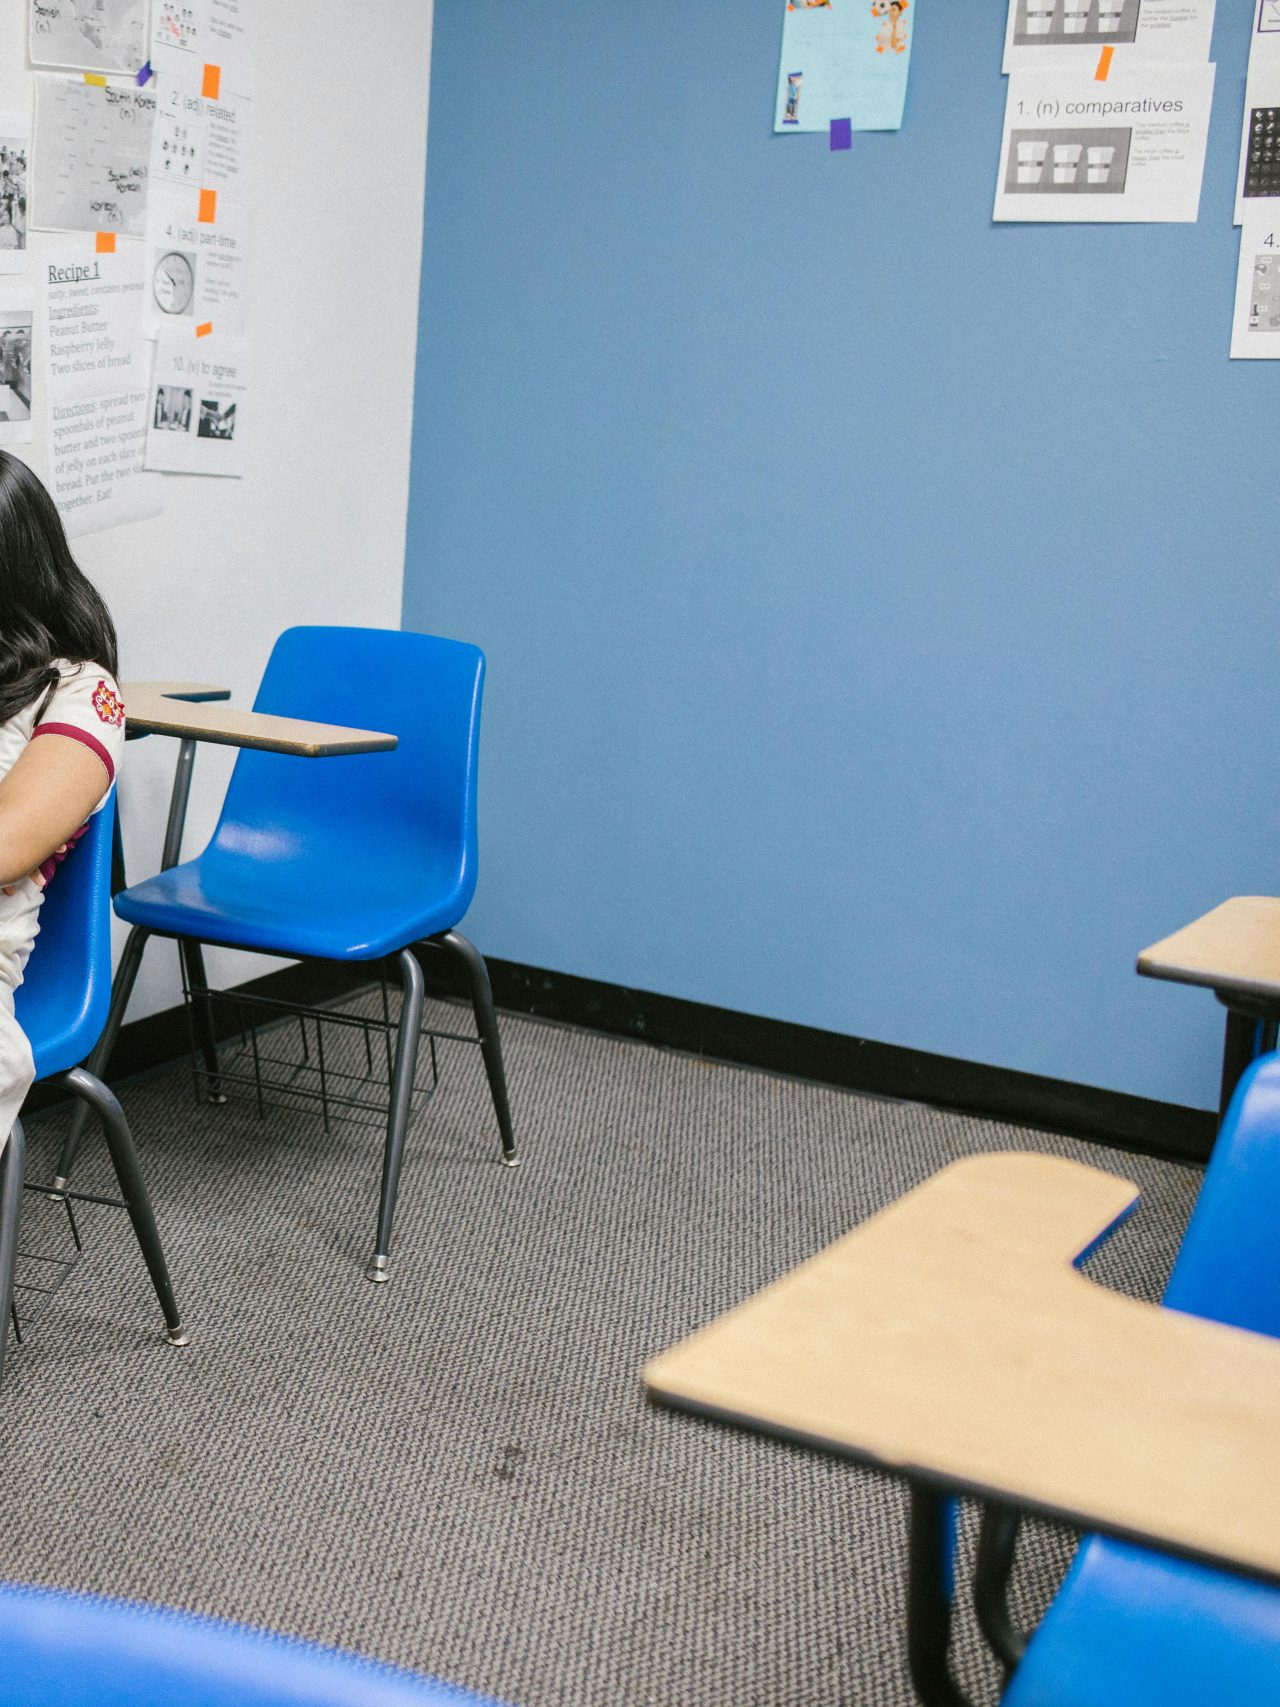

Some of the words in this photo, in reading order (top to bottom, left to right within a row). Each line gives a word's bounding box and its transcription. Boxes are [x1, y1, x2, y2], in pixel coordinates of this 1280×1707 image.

[1017, 101, 1030, 115] 1.
[1036, 100, 1060, 118] (n)
[1065, 98, 1183, 116] comparatives
[48, 264, 90, 282] Recipe
[93, 261, 100, 277] 1
[50, 362, 71, 376] Two
[97, 356, 106, 369] of
